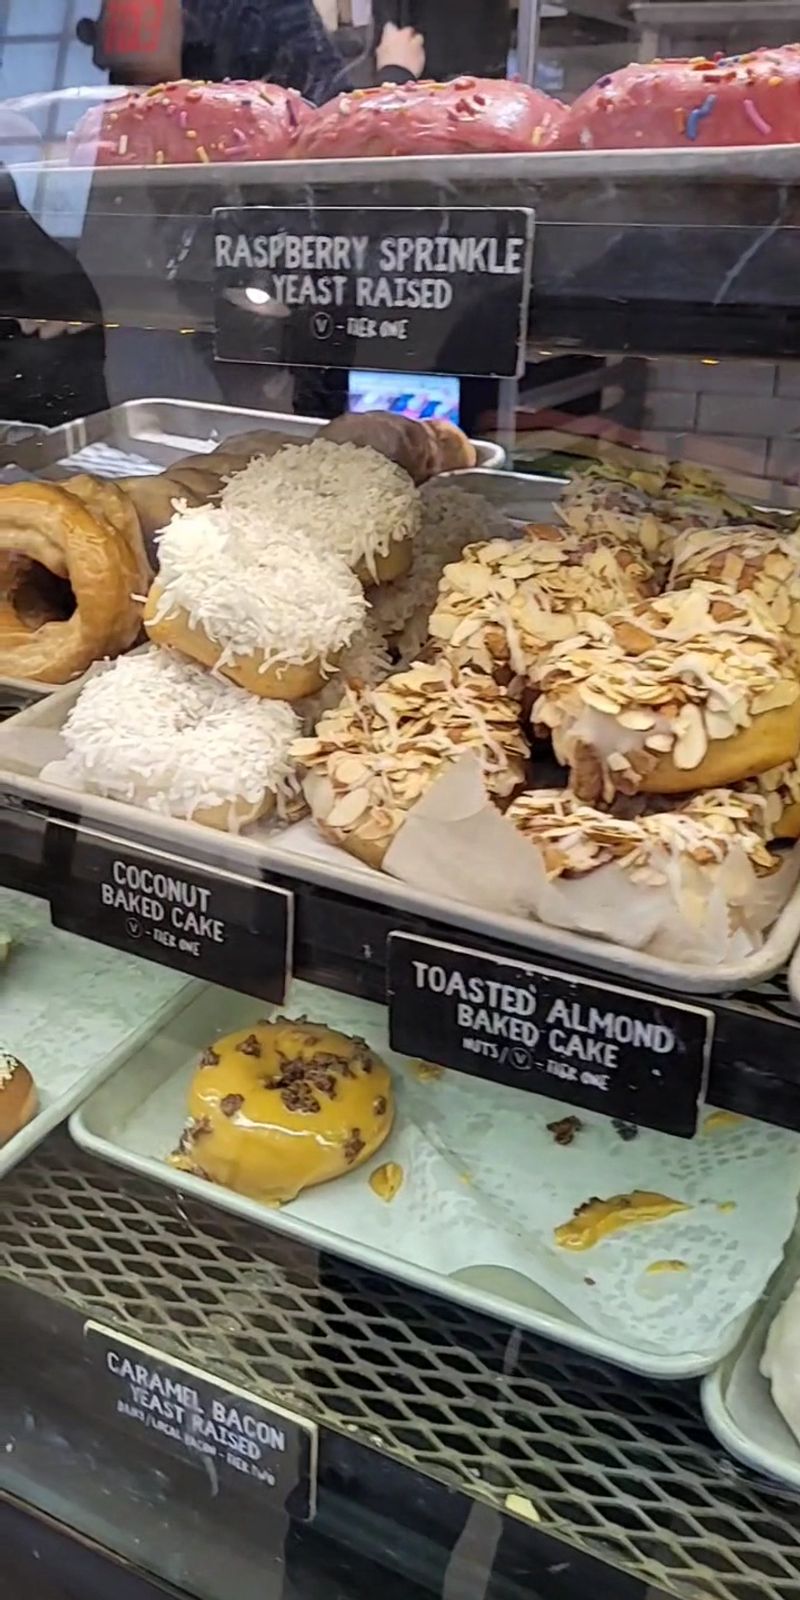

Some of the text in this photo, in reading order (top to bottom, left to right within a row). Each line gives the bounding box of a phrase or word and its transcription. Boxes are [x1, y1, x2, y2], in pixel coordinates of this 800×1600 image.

[214, 233, 525, 275] RASPBERRY SPRINKLE
[272, 273, 452, 310] YEAST RAISED
[101, 883, 225, 943] BAKED CAKE
[113, 860, 211, 913] COCONUT
[412, 960, 676, 1054] TOASTED ALMOND
[457, 1003, 619, 1069] BAKED CAKE
[106, 1351, 286, 1452] CARAMEL BACON
[130, 1383, 262, 1461] YEAST RAISED
